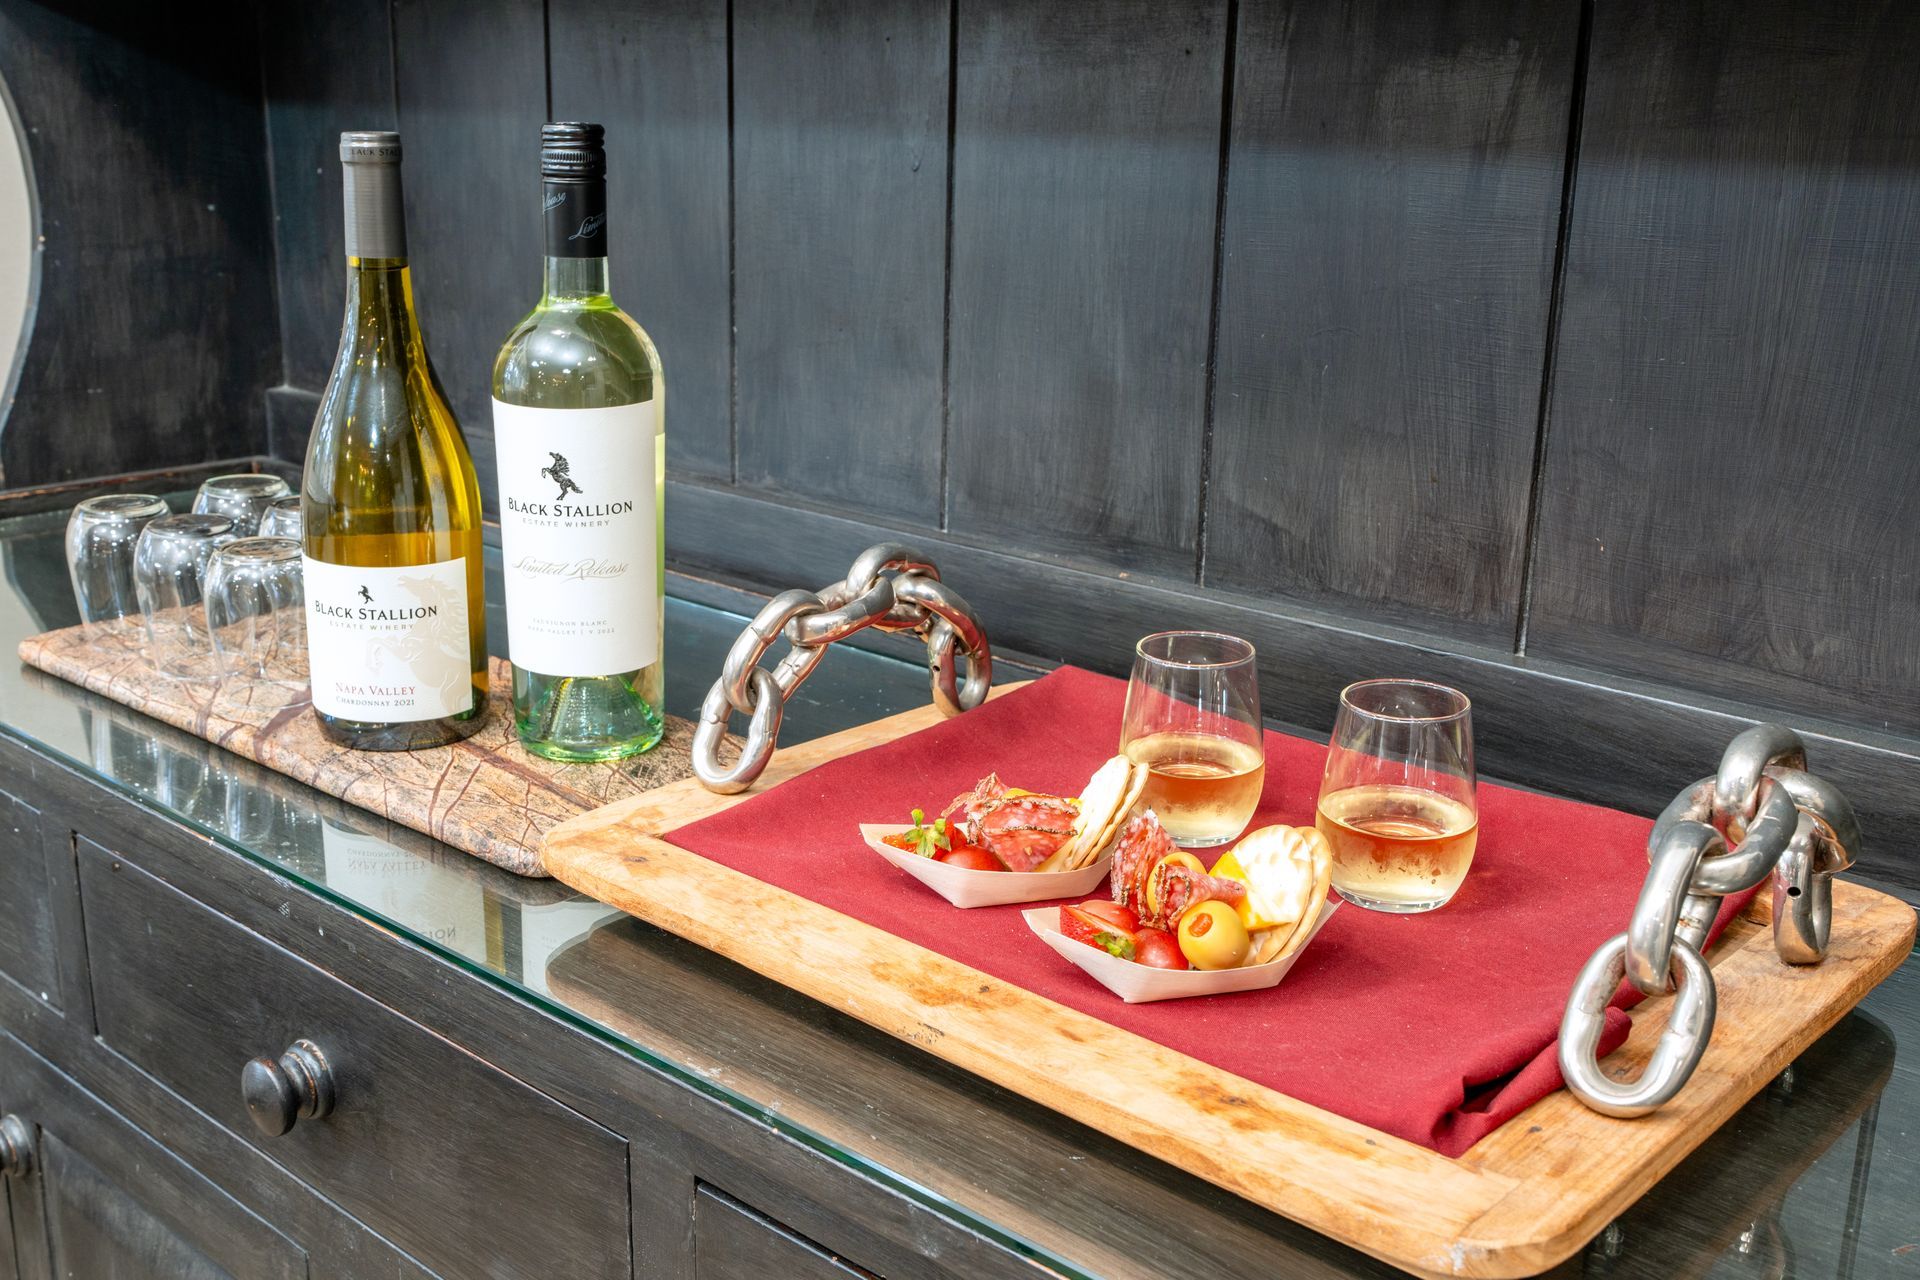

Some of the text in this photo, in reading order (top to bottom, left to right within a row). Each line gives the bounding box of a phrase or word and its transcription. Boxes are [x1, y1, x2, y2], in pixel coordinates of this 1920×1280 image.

[350, 148, 375, 157] LACK
[508, 497, 633, 517] BLACK STALLION
[522, 517, 610, 528] ESTATE WINERY
[512, 556, 630, 582] Limited Release
[315, 600, 438, 621] BLACK STALLION
[329, 620, 414, 631] ESTATE WINERY
[335, 682, 416, 696] NAPA VALLEY
[335, 696, 390, 707] CHARDONNAY
